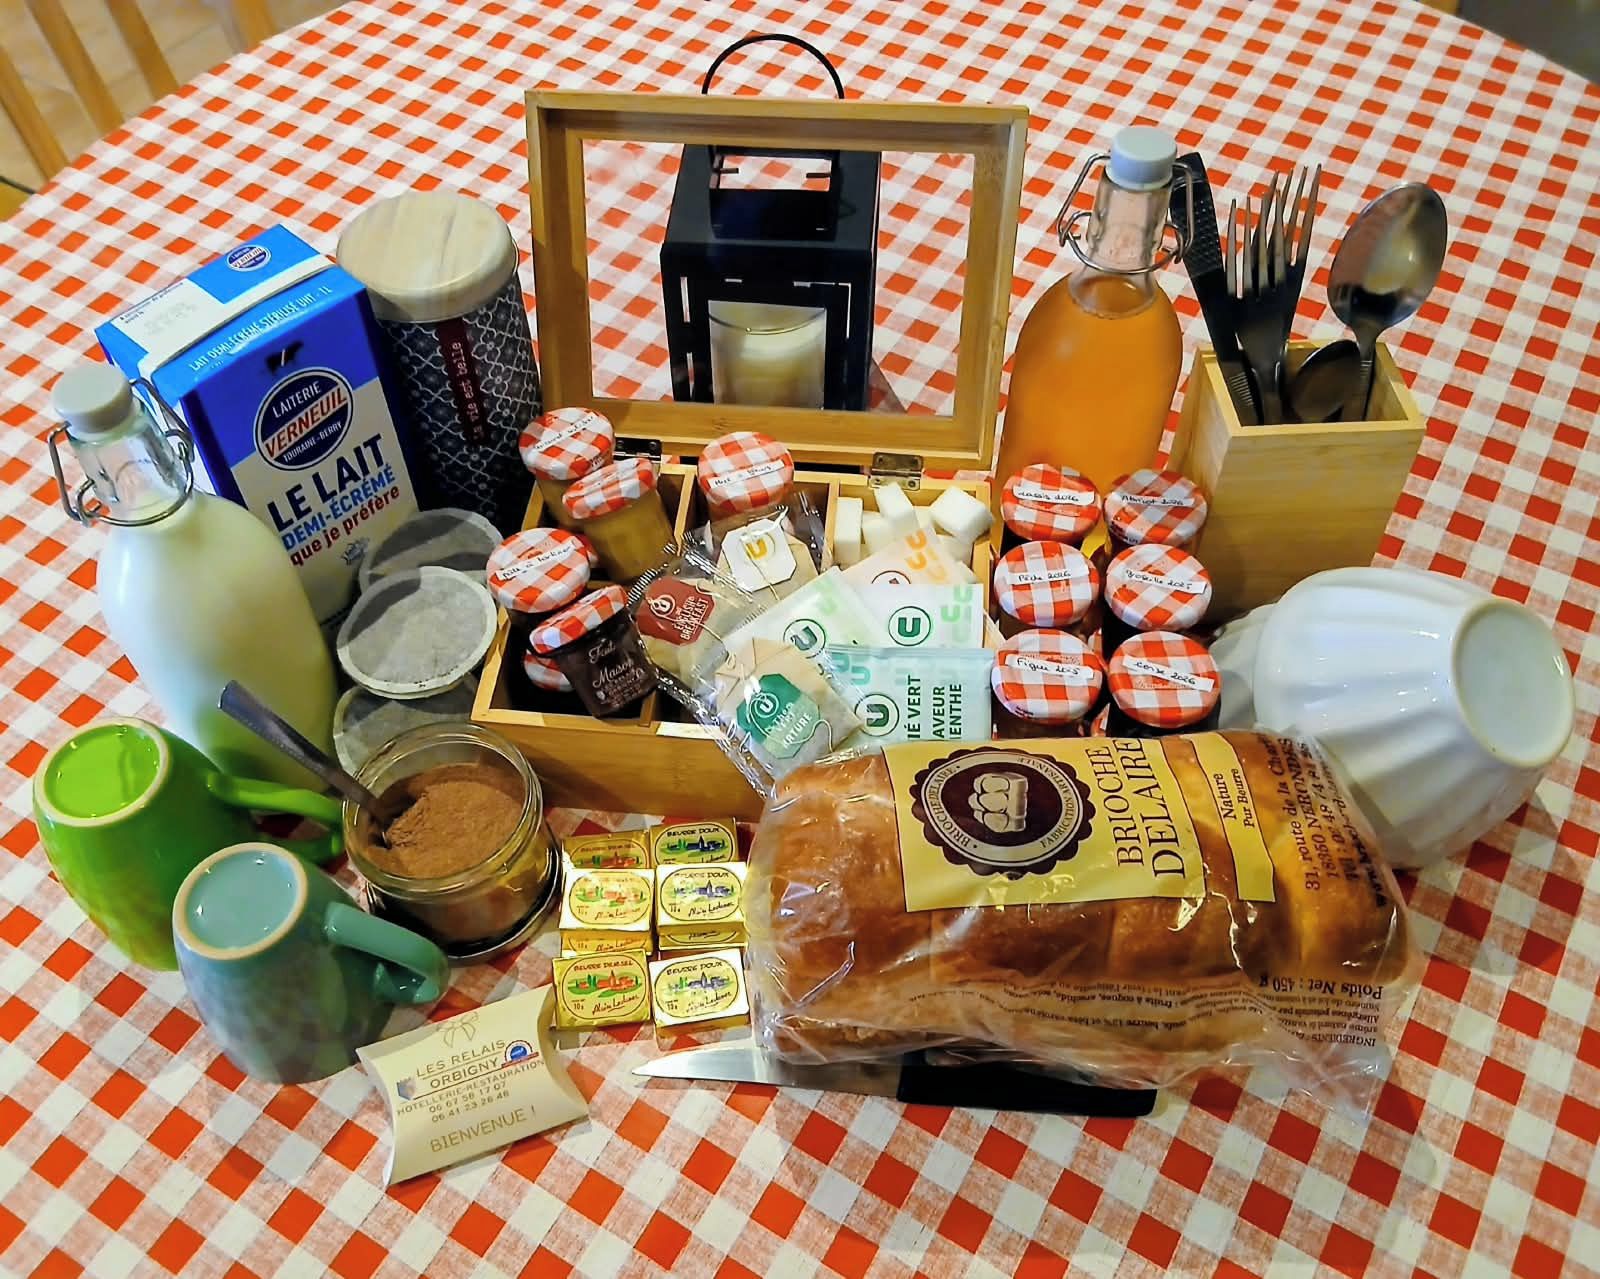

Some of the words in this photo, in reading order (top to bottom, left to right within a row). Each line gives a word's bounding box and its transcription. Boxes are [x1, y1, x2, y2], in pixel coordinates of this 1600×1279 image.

[452, 342, 468, 376] belle
[272, 381, 321, 418] LAITERIE
[264, 388, 347, 458] VERNEUIL
[267, 484, 312, 532] LE
[312, 434, 386, 504] LAIT
[281, 464, 396, 551] DEMI-ÉCRÉMÉ
[290, 539, 322, 566] que
[324, 527, 340, 548] je
[342, 486, 400, 535] préfère
[680, 598, 709, 640] BREAKFAST
[898, 617, 922, 638] U
[908, 674, 922, 720] VERT
[932, 686, 946, 739] AVEUR
[949, 683, 962, 740] ENTHE
[1085, 746, 1144, 867] BRIOCHE
[1213, 773, 1237, 820] Nature
[1230, 768, 1250, 804] Beurre
[1277, 782, 1292, 796] la
[1112, 738, 1186, 879] DELAIRE
[1244, 806, 1256, 828] Pur
[1282, 800, 1297, 816] de
[1290, 820, 1312, 862] route
[1272, 977, 1295, 992] 450
[1309, 979, 1335, 994] Net
[1341, 982, 1384, 1000] Poids
[416, 1060, 446, 1078] LES
[451, 1039, 506, 1065] RELAIS
[430, 1057, 499, 1089] ORBIGNY
[430, 1108, 527, 1152] BIENVENUE
